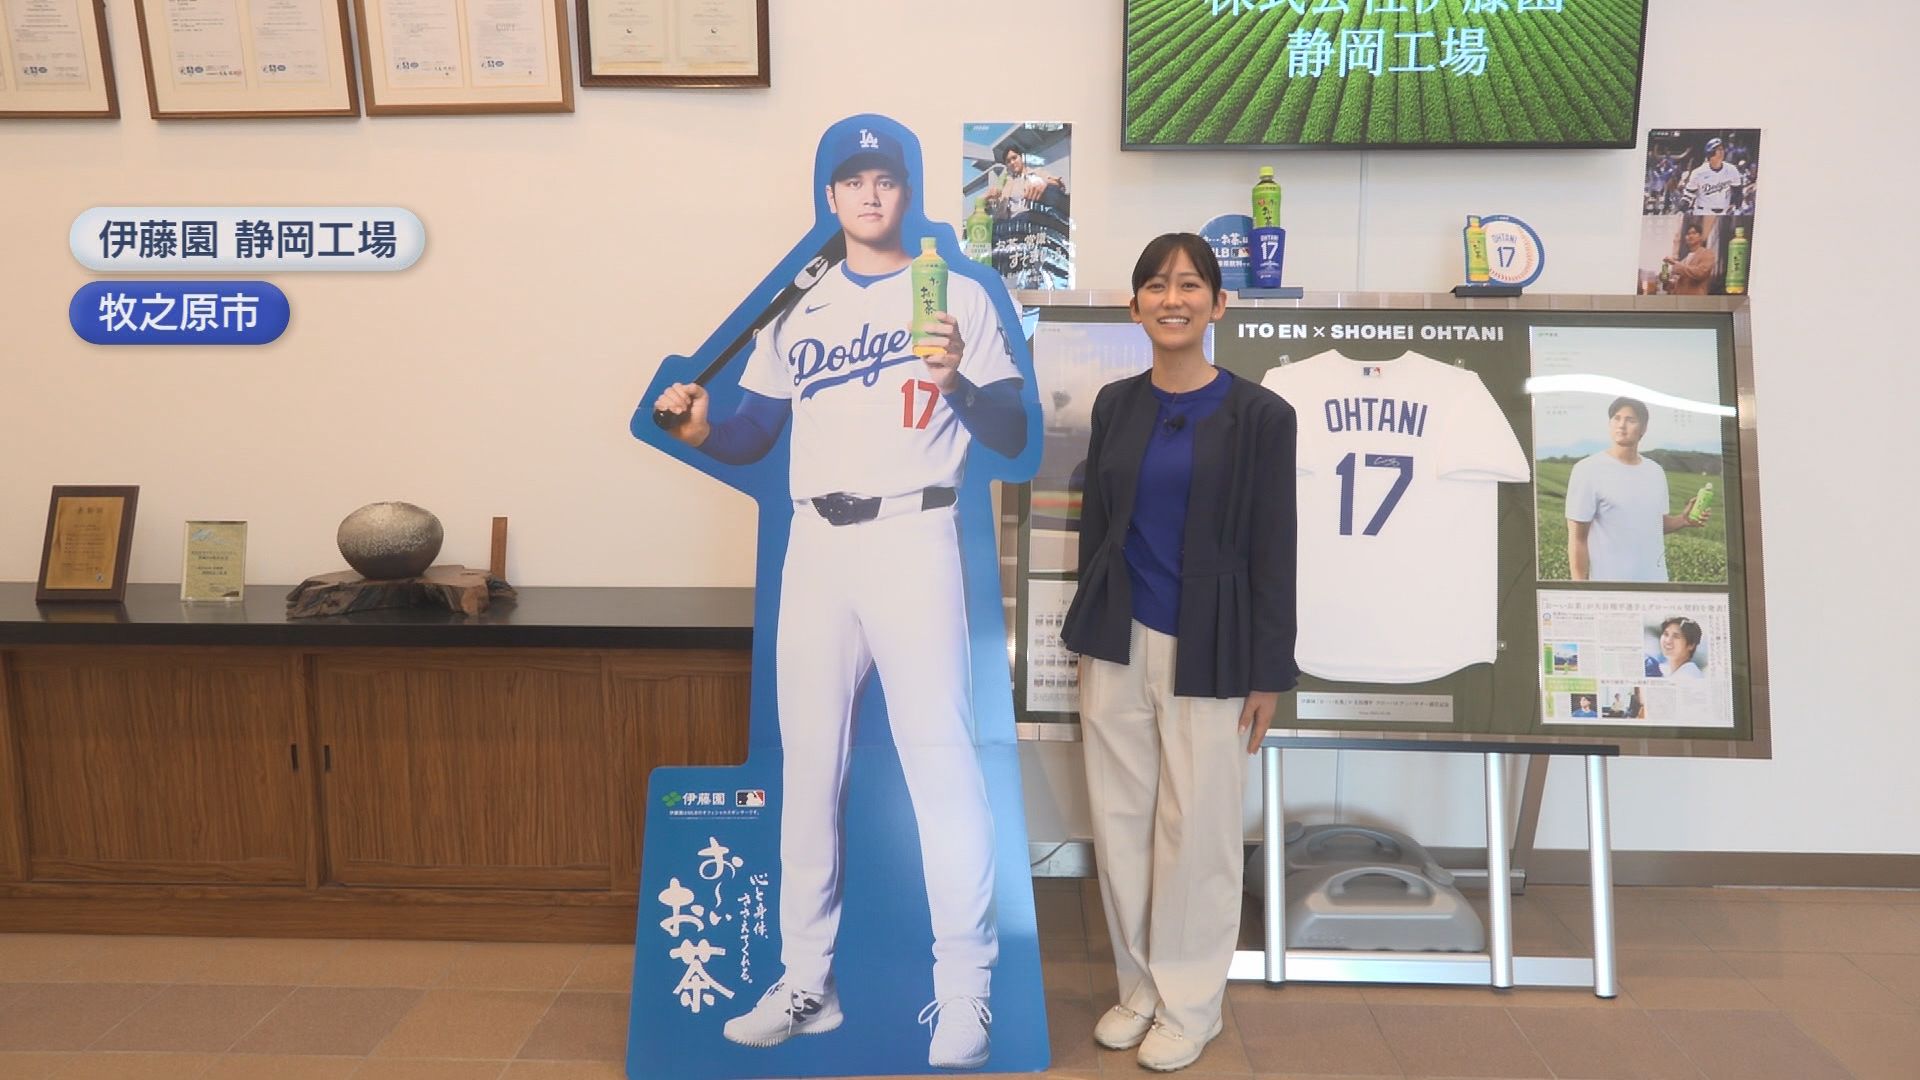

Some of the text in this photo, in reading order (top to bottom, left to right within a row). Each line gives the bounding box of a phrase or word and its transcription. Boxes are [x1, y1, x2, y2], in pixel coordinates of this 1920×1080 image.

[1287, 27, 1490, 78] 静岡工場
[1261, 242, 1278, 260] 17
[1497, 246, 1516, 268] 17
[1238, 323, 1274, 338] ITO
[1278, 324, 1307, 338] EN
[1330, 323, 1414, 340] SHOHEI
[1420, 325, 1504, 341] OHTANI
[788, 322, 911, 388] Dodge
[901, 378, 940, 430] 17
[1324, 397, 1428, 437] OHTANI
[1335, 452, 1414, 536] 17
[682, 792, 726, 806] 伊藤園
[657, 877, 735, 1013] お茶
